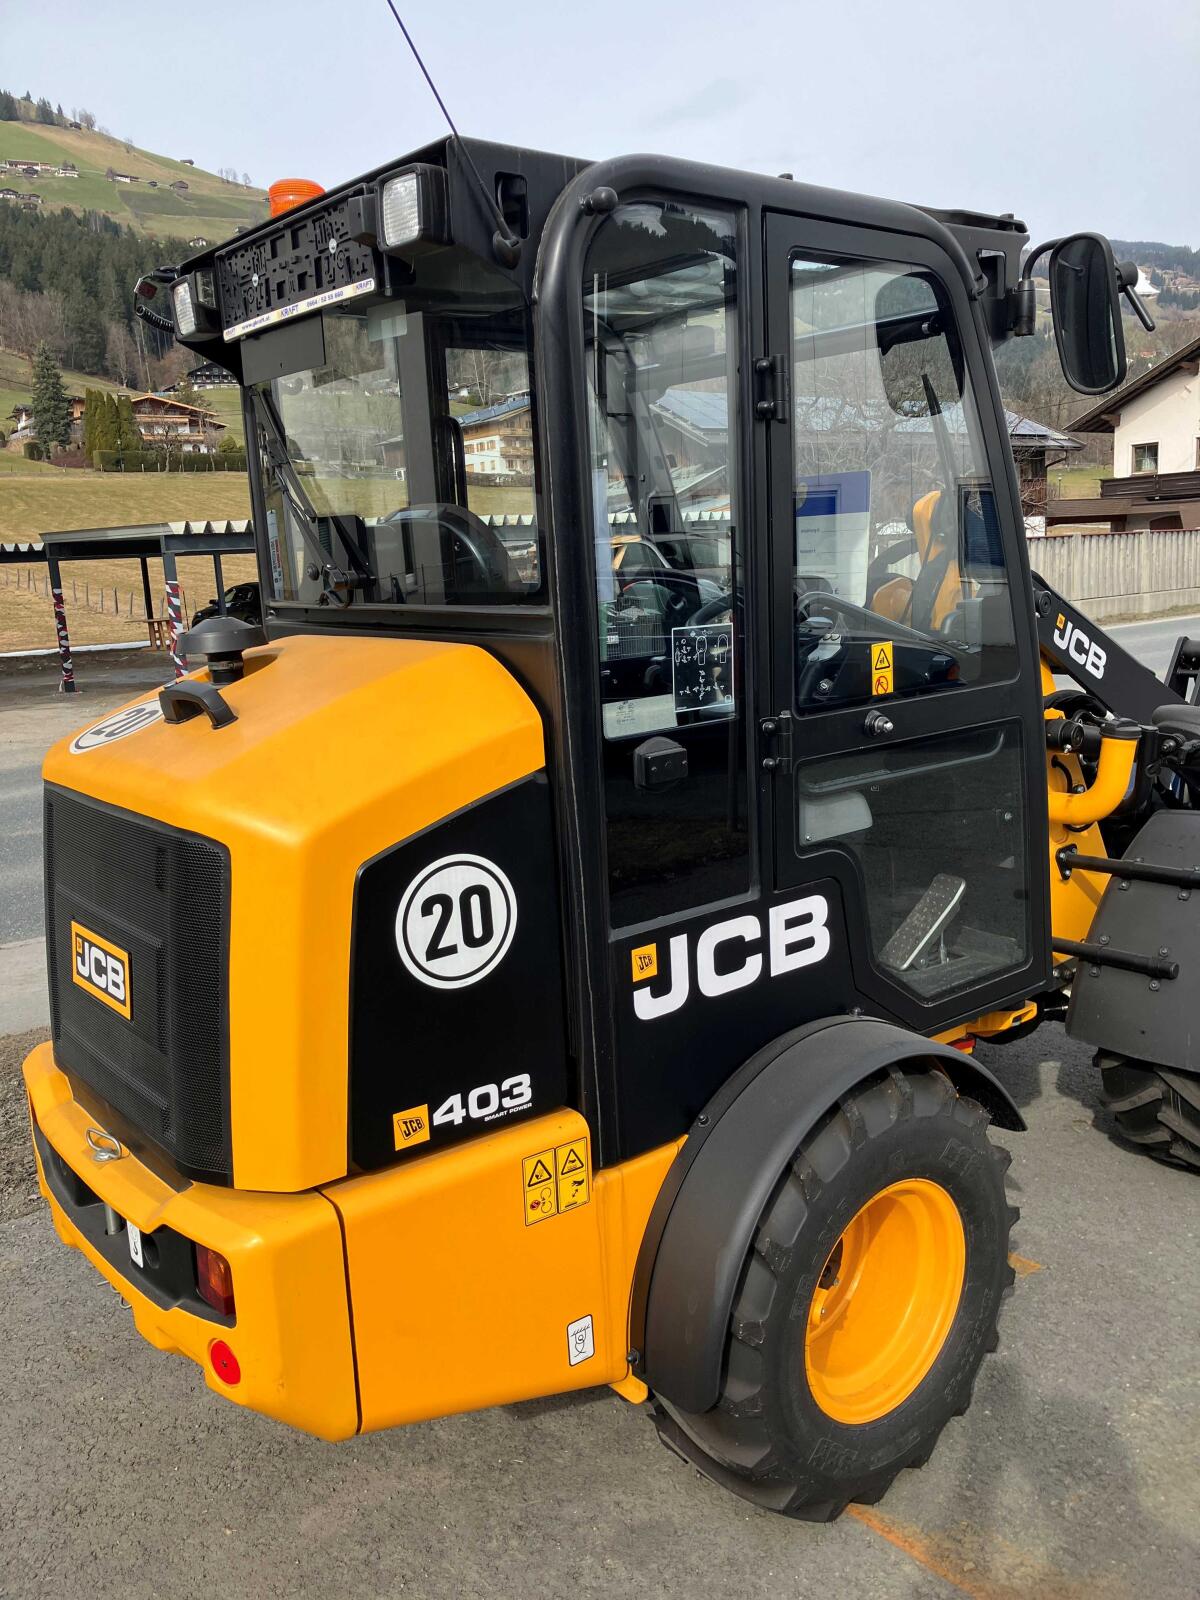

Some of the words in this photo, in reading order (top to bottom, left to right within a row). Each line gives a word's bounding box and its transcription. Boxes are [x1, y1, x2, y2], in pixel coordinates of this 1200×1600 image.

[280, 304, 299, 318] KRAFT
[355, 280, 373, 292] KRAFT
[1053, 620, 1107, 679] JCB
[89, 707, 160, 737] 20
[421, 884, 494, 962] 20
[76, 941, 125, 1001] JCB
[633, 894, 831, 1021] JCB
[638, 955, 653, 971] JCB
[432, 1073, 532, 1126] 403
[484, 1110, 508, 1122] SMART
[509, 1102, 533, 1114] POWER
[402, 1119, 424, 1138] JCB
